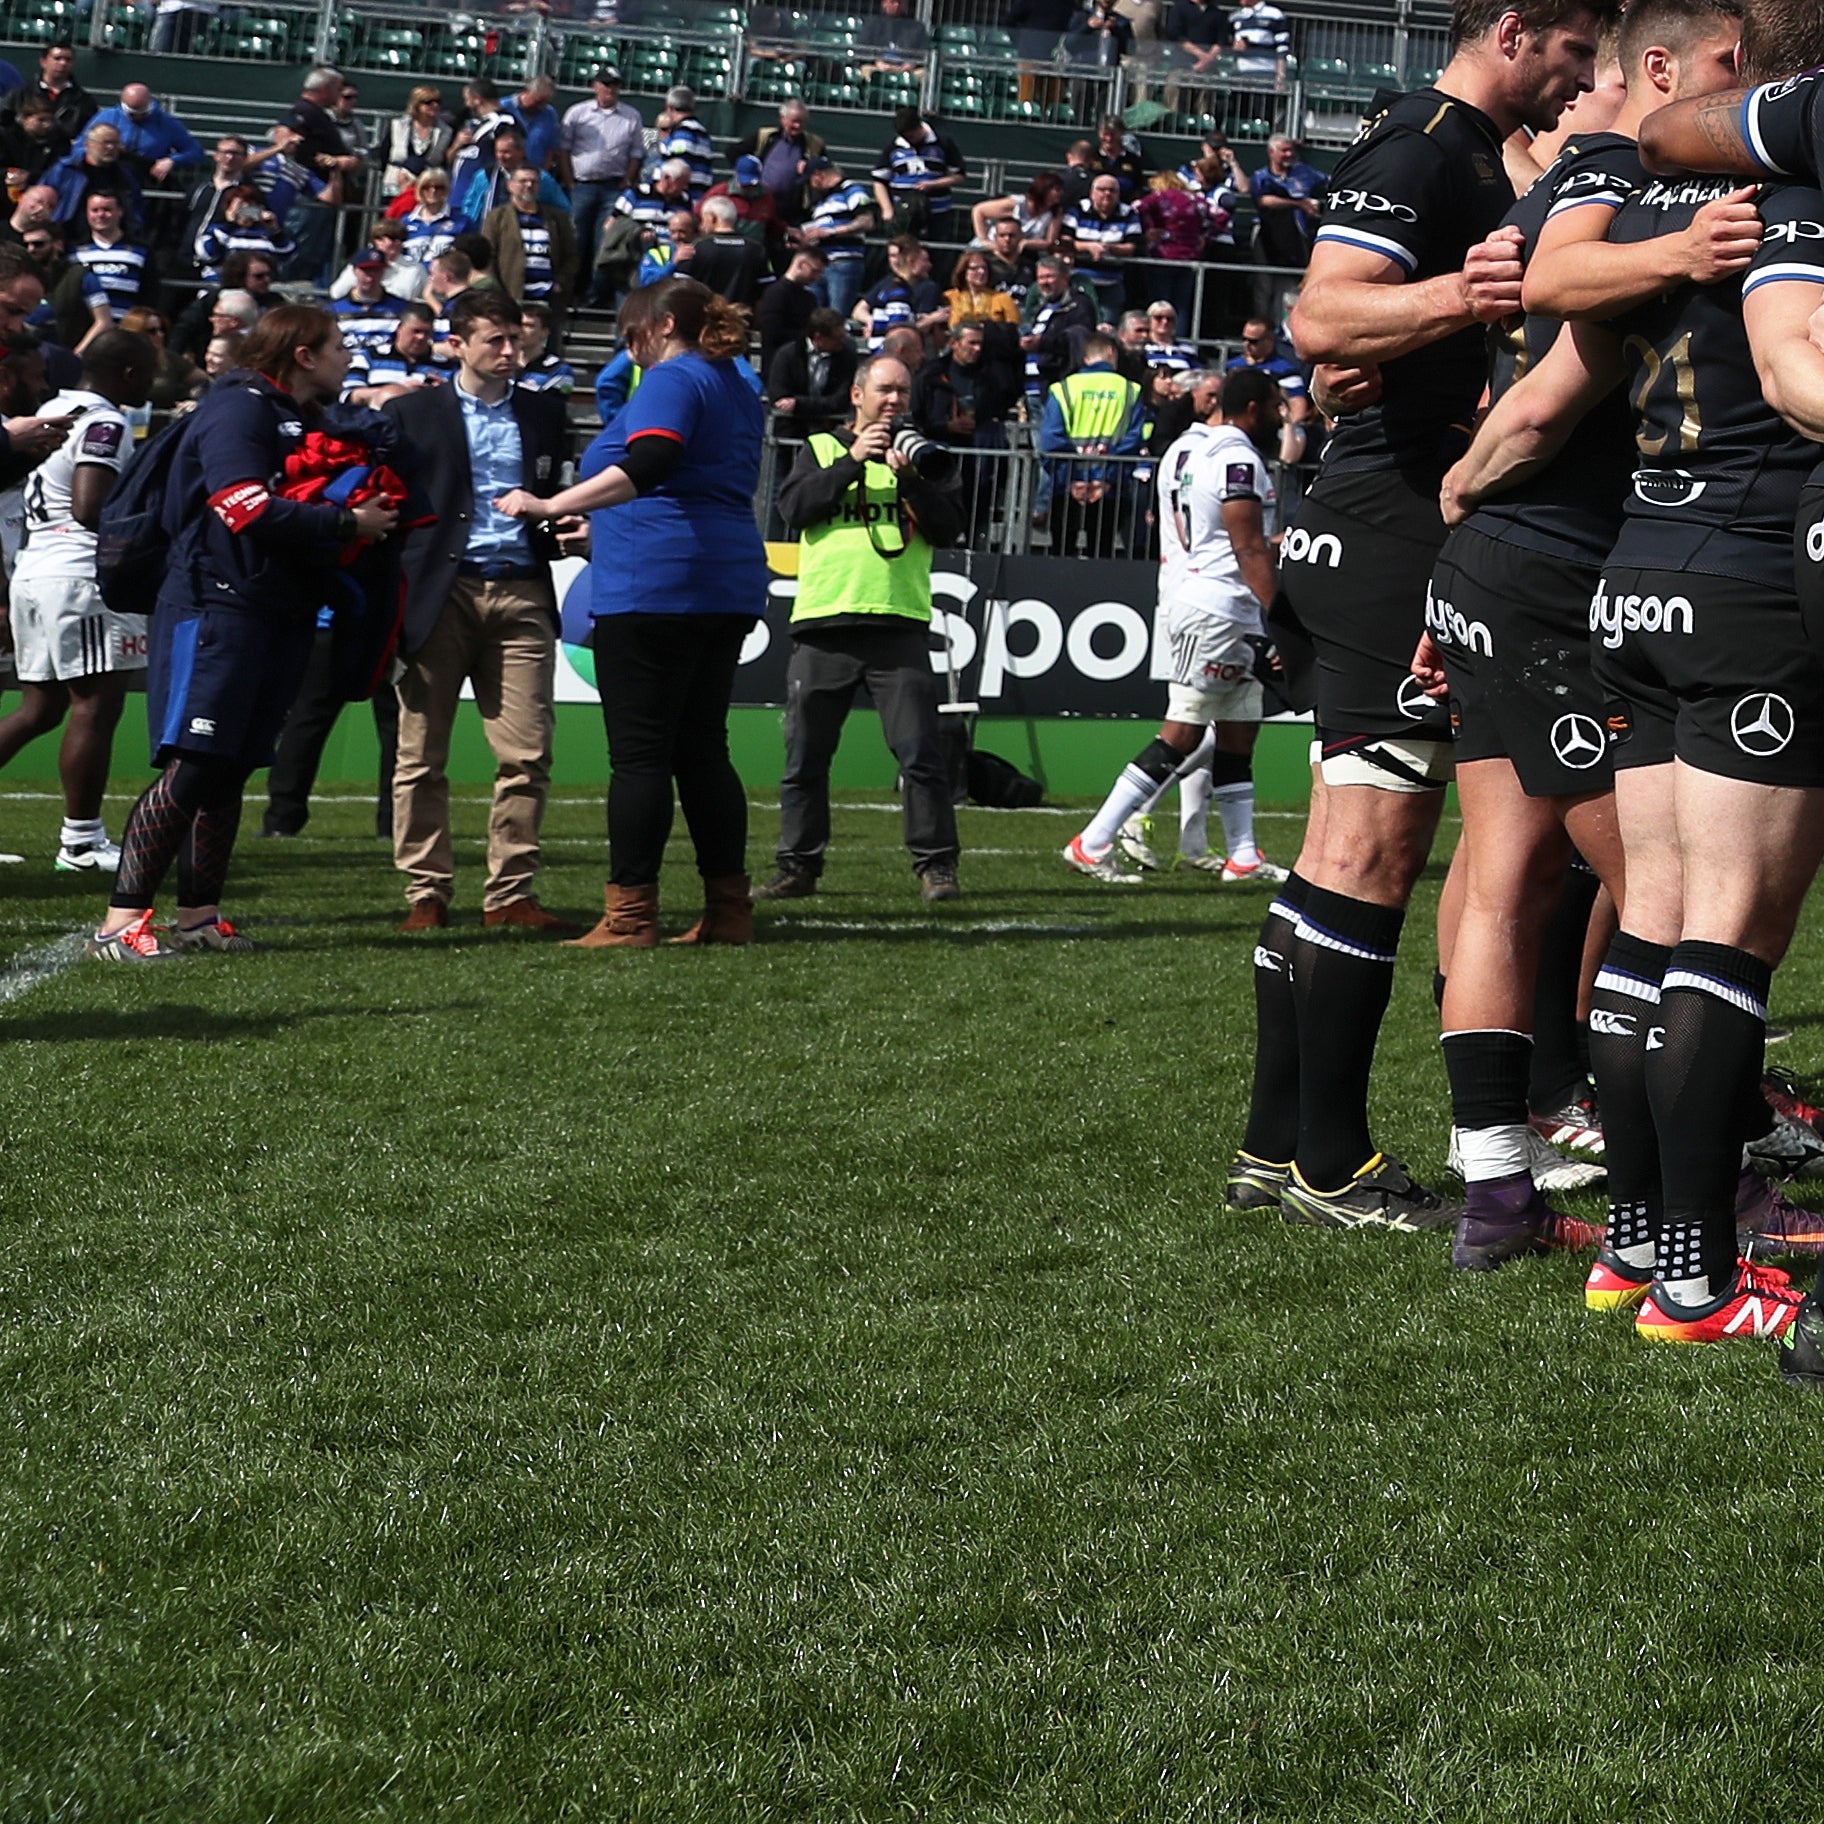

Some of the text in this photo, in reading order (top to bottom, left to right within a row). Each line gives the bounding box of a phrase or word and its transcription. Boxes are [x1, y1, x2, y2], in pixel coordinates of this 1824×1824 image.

[1622, 330, 1703, 457] 21
[120, 635, 148, 656] HO
[929, 571, 1171, 698] Spo
[1589, 578, 1694, 649] dyson
[1204, 662, 1246, 680] HO
